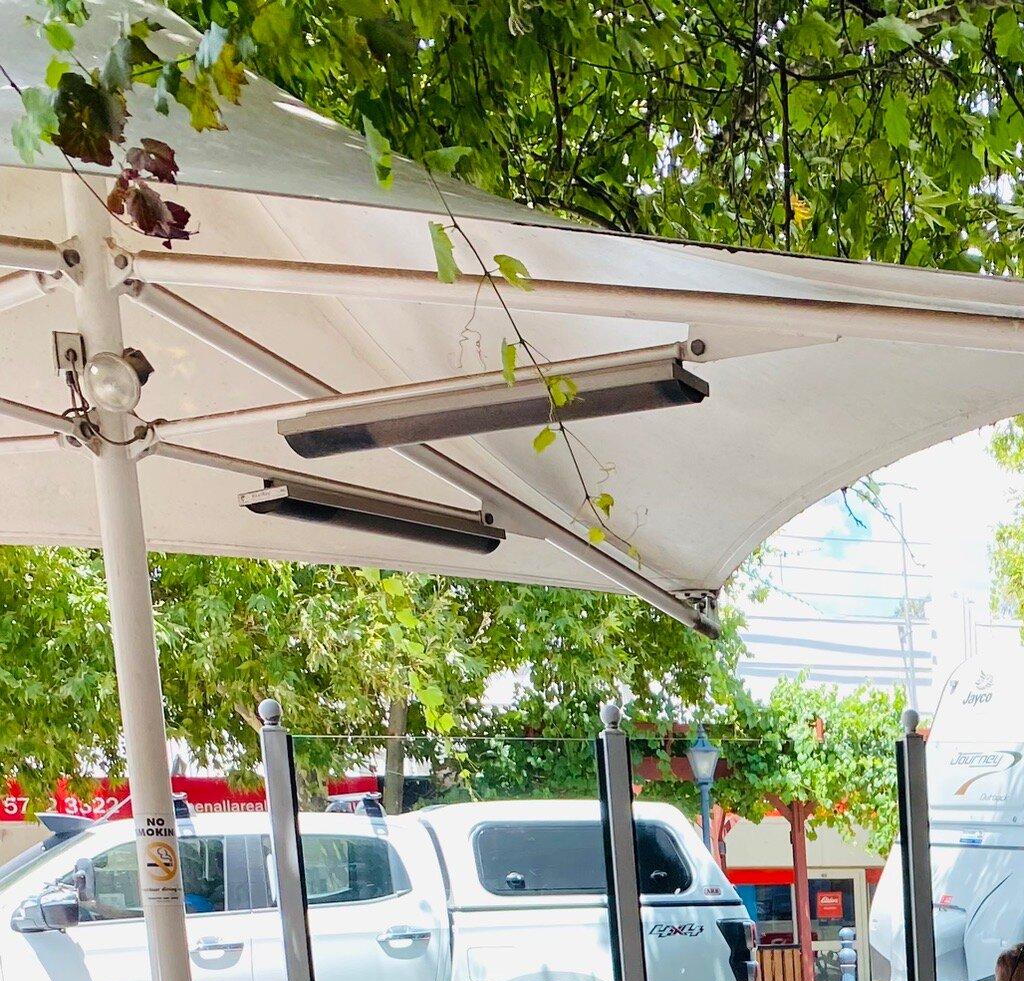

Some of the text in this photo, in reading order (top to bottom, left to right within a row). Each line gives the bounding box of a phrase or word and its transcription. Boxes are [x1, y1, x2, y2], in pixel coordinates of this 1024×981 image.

[962, 690, 993, 707] Jayco
[950, 752, 1003, 768] Journey
[146, 817, 165, 827] NO
